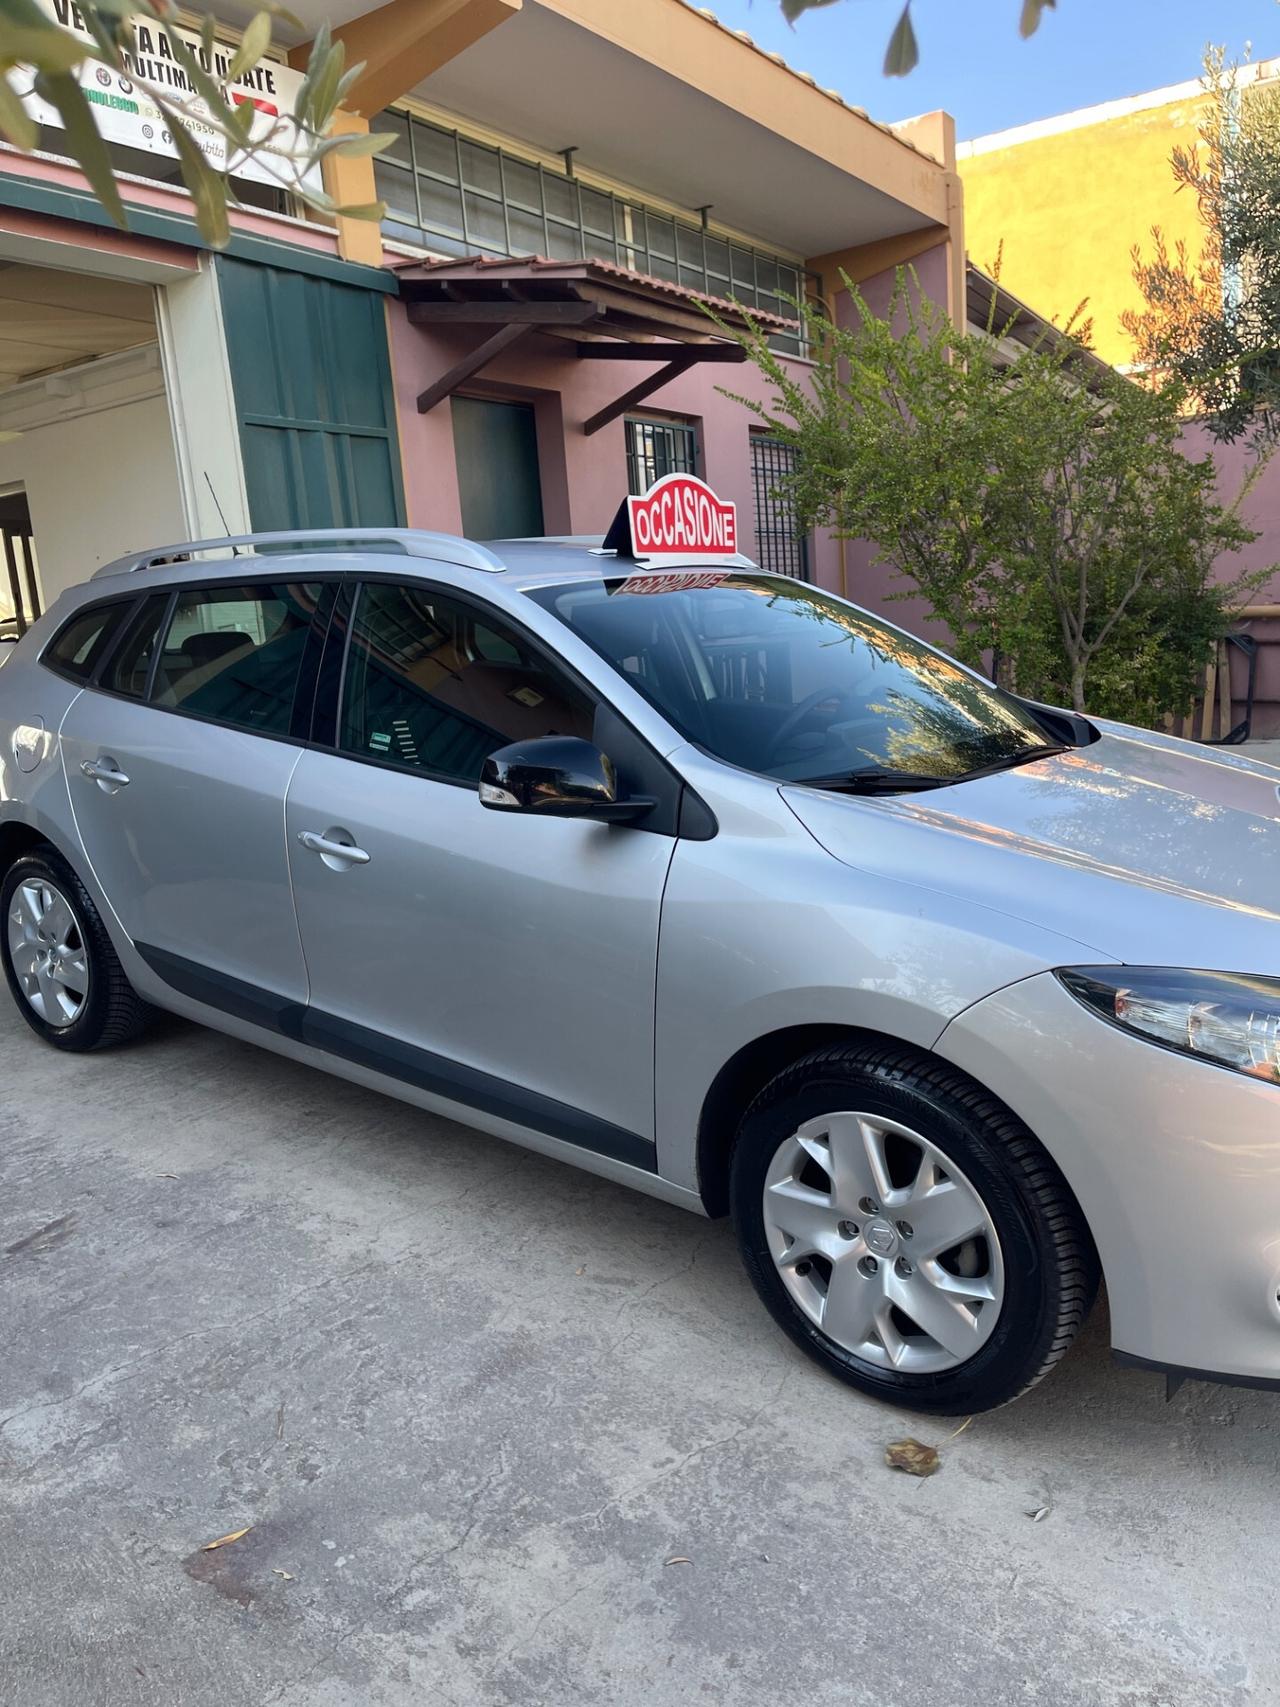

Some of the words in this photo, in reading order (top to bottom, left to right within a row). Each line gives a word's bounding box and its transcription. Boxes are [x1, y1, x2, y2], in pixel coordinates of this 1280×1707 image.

[120, 50, 230, 105] MULTIMAA
[158, 32, 211, 74] ATO
[214, 53, 276, 95] UATE
[198, 141, 225, 158] ubito
[636, 486, 734, 547] OCCASIONE
